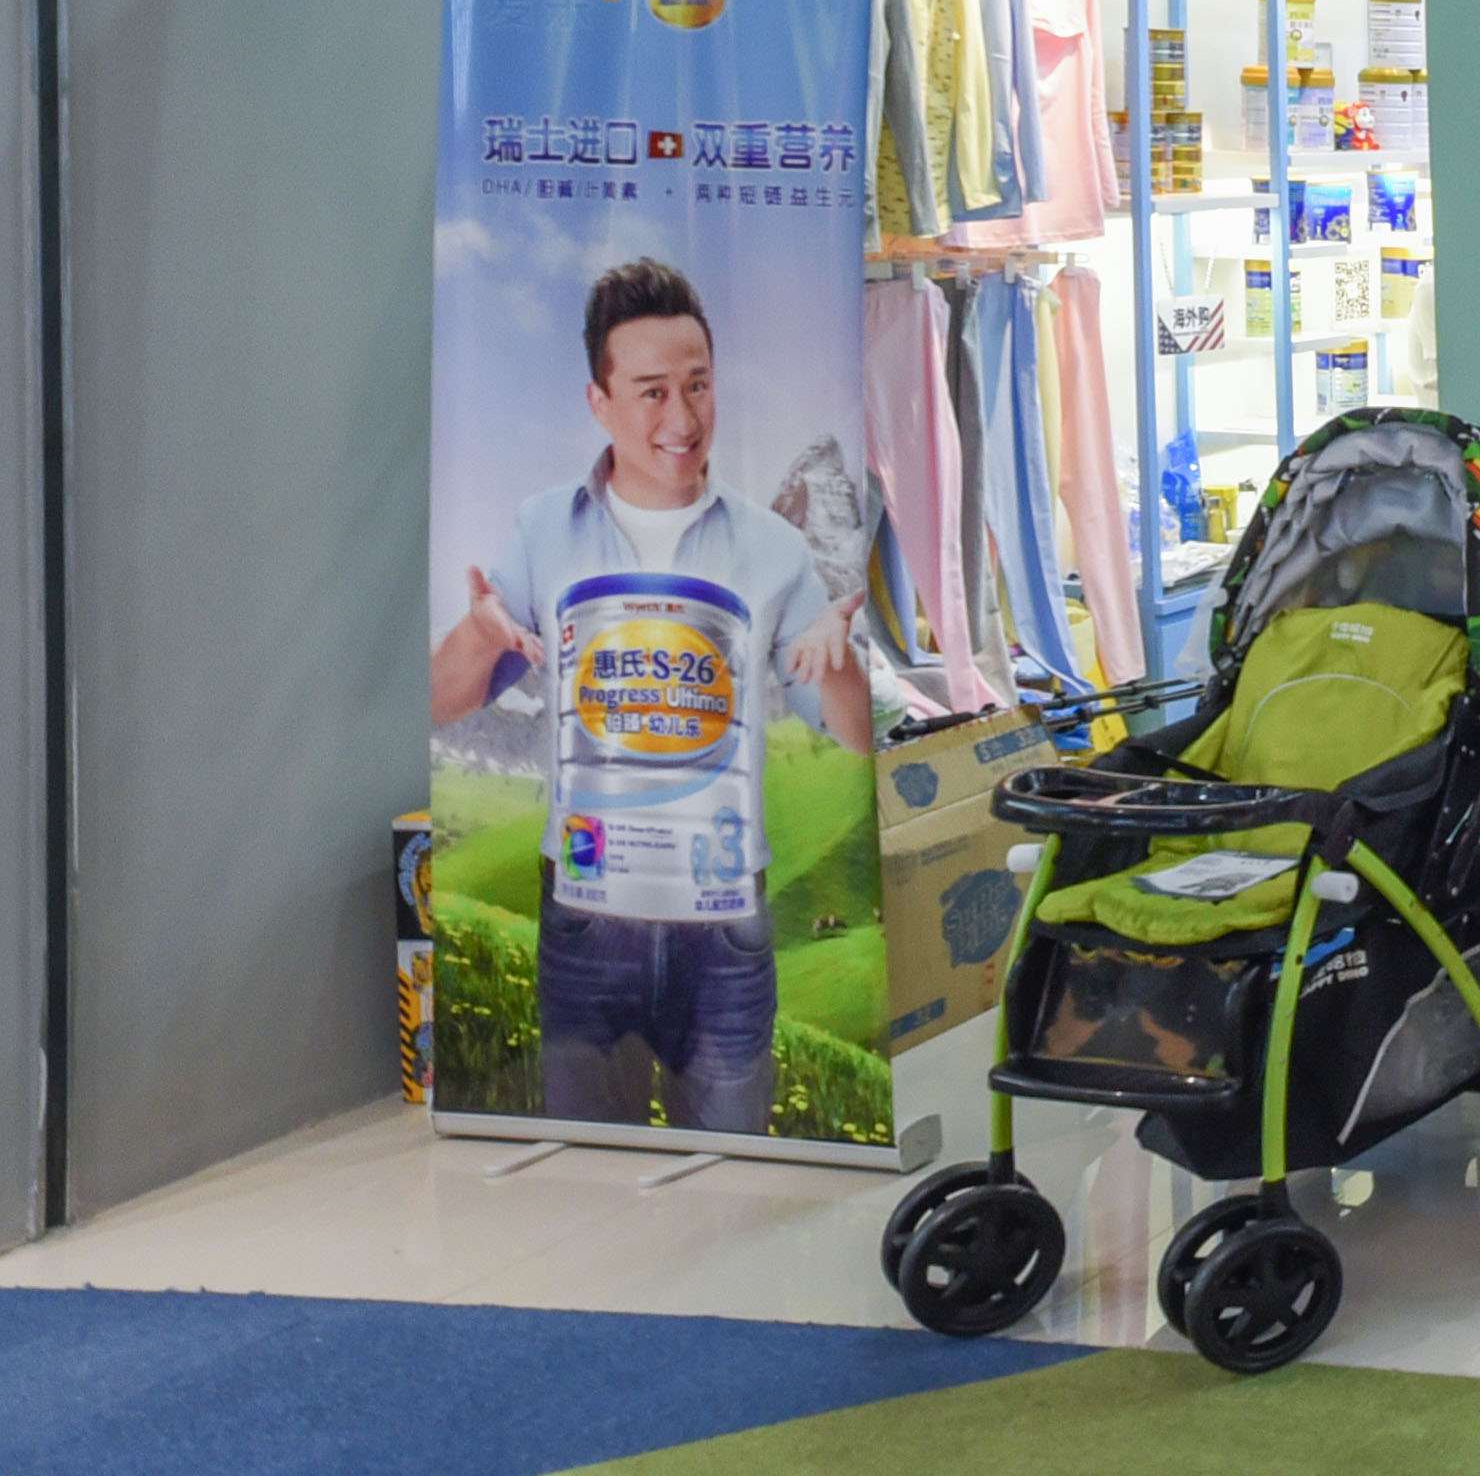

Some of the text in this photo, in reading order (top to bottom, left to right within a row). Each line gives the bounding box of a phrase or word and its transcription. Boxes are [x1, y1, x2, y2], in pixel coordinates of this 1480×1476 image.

[483, 116, 857, 172] 瑞士进口 双重营养
[593, 649, 646, 679] 惠氏
[651, 649, 718, 685] S-26
[578, 685, 728, 714] Progress Ultima
